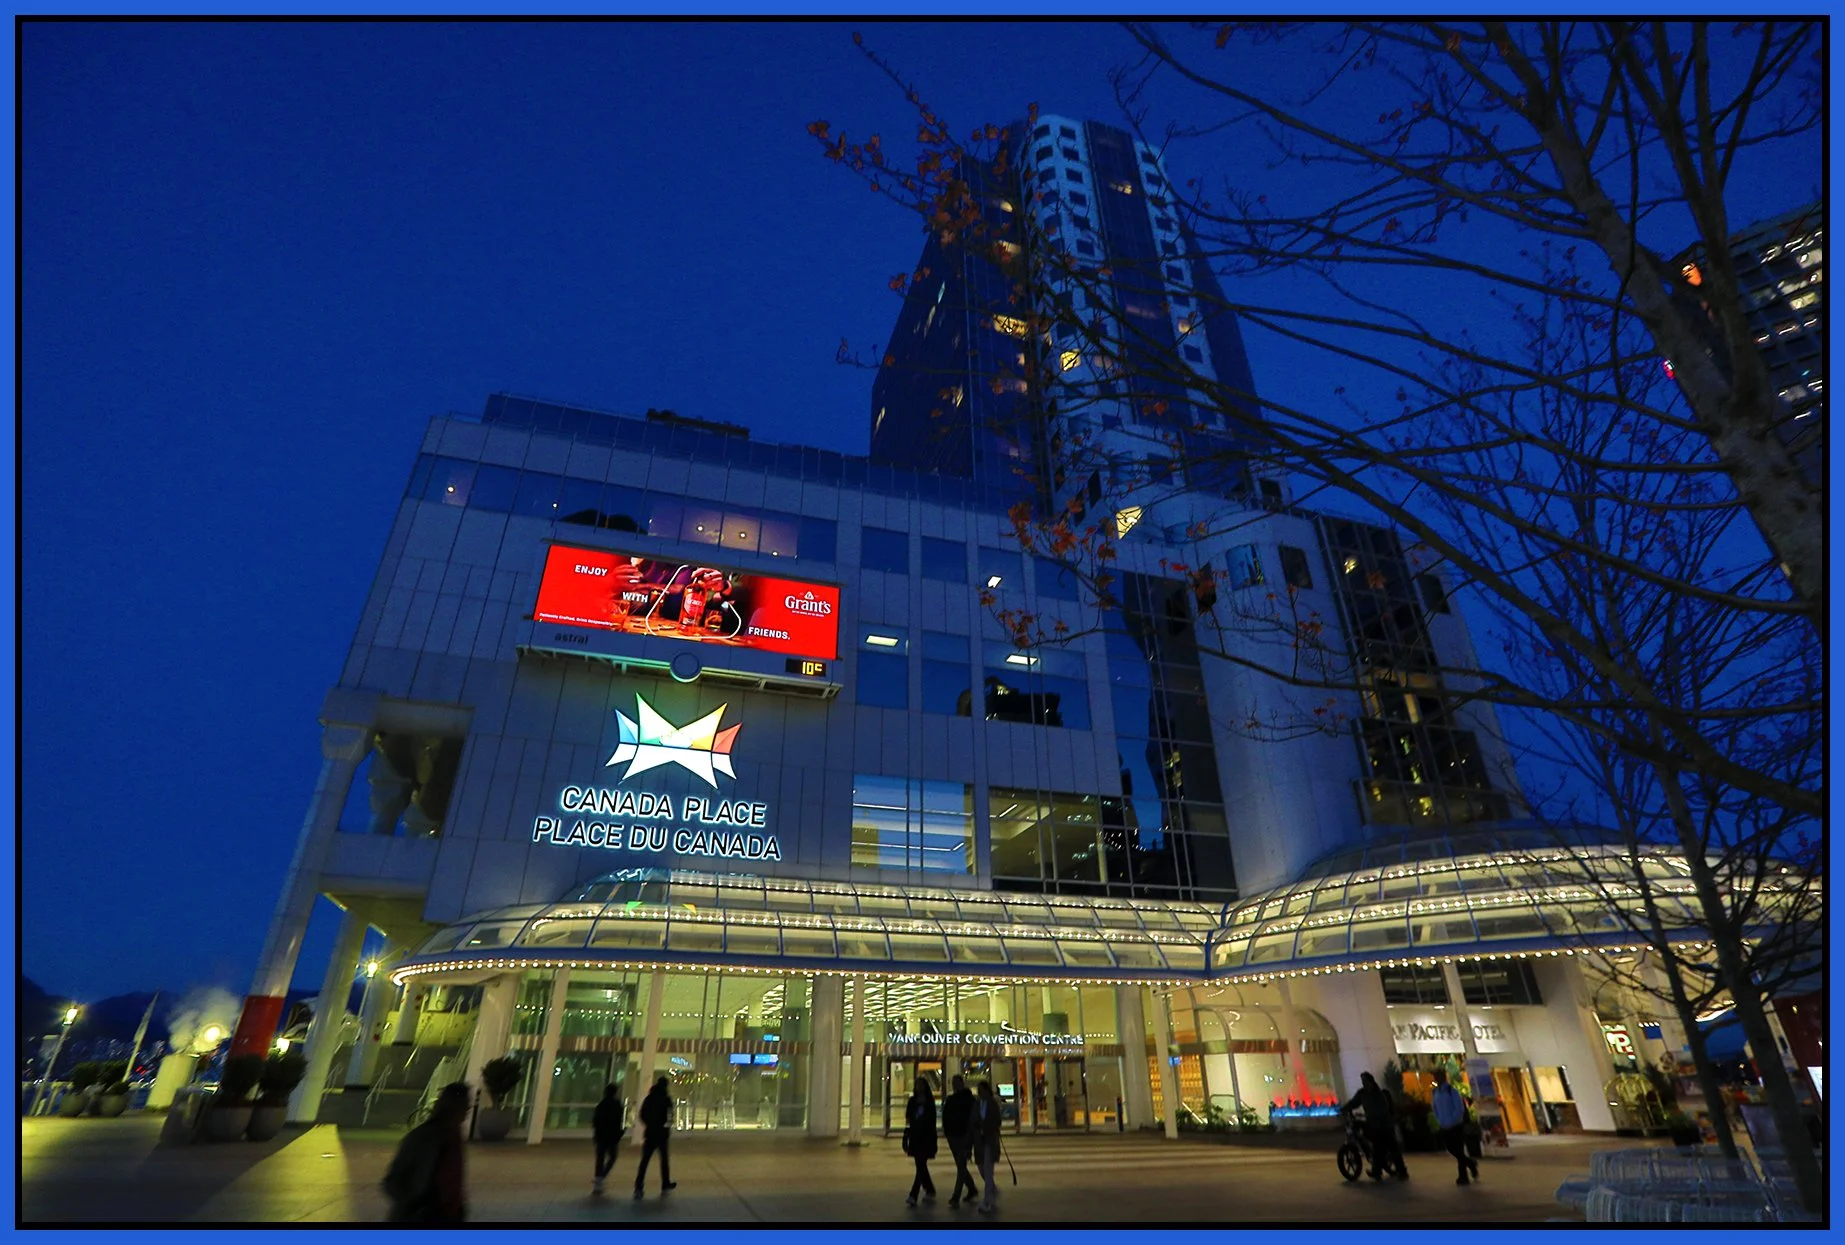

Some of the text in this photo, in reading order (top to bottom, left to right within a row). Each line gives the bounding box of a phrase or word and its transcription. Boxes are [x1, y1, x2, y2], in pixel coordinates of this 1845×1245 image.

[574, 564, 608, 577] ENJOY
[622, 591, 649, 603] WITH
[784, 594, 832, 614] Grant's
[554, 632, 589, 645] astral
[748, 626, 791, 640] FRIENDS.
[561, 785, 766, 826] CANADA PLACE
[533, 817, 781, 860] PLACE DU CANADA
[888, 1032, 1084, 1045] VANCOUVER CONVENTION CENTRE
[1408, 1023, 1460, 1040] PACIFIC
[1472, 1025, 1506, 1040] OTEL
